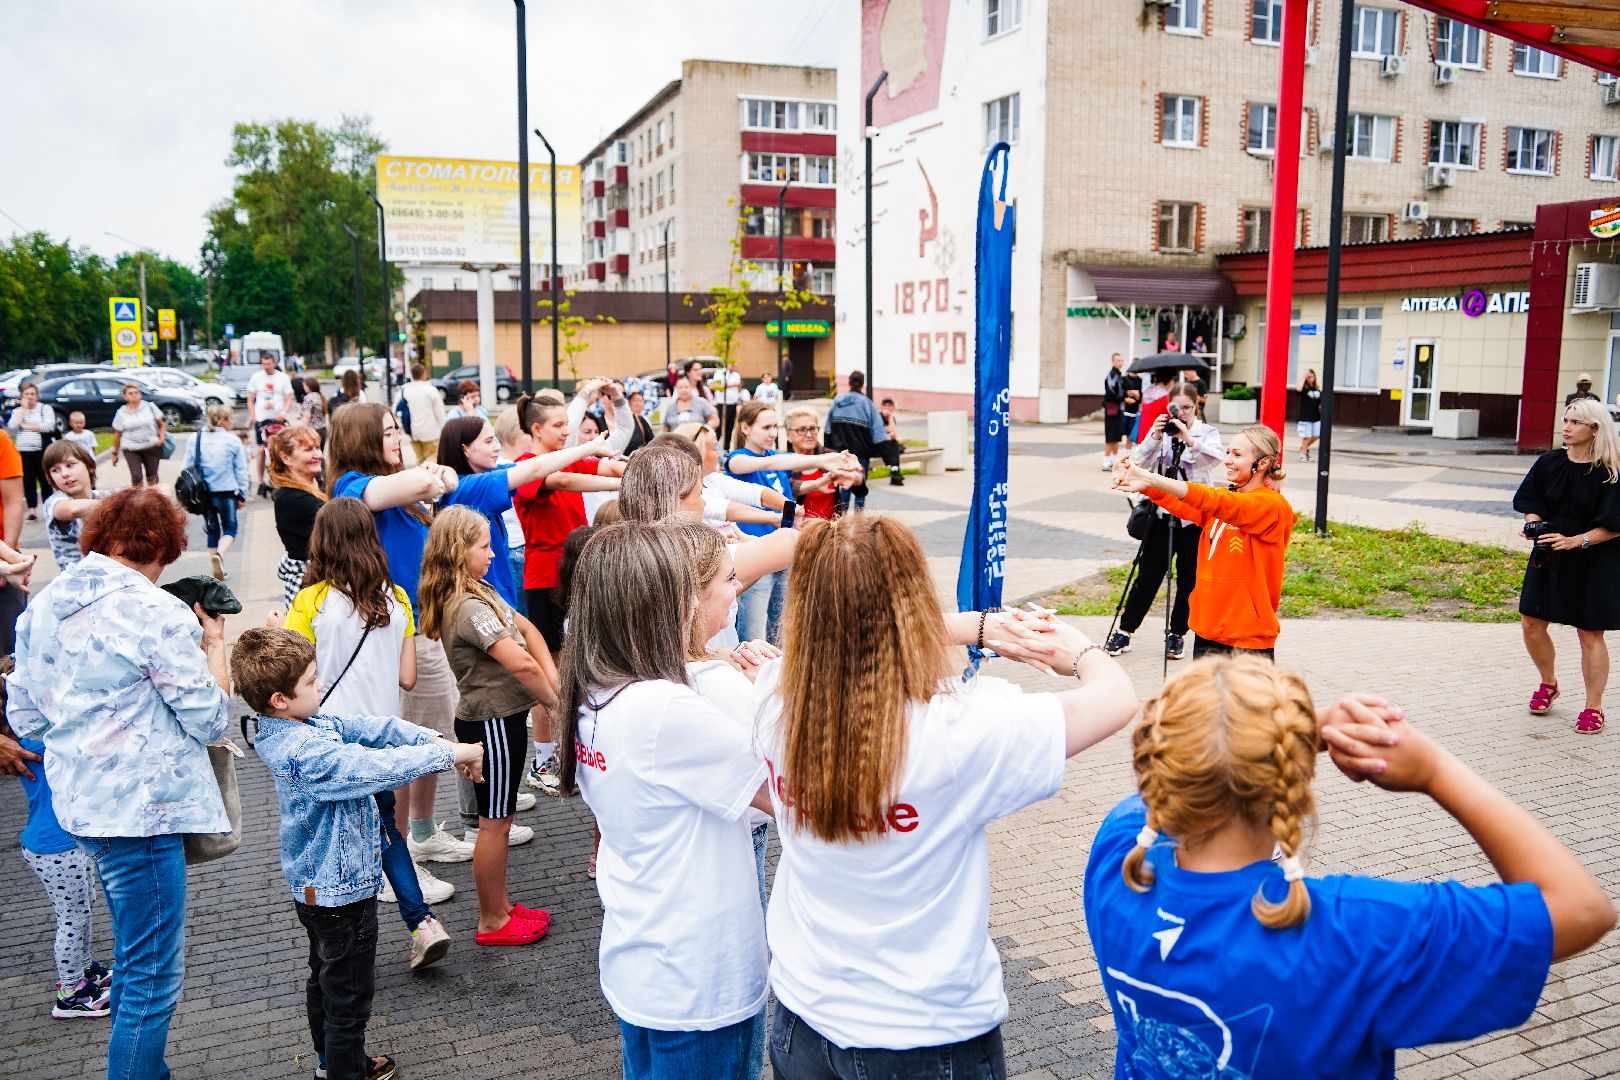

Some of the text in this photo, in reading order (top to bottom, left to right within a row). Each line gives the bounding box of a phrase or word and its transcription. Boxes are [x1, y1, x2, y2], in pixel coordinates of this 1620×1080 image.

[895, 278, 949, 315] 1870
[1400, 296, 1458, 312] АПТЕКА
[910, 331, 967, 364] 1970
